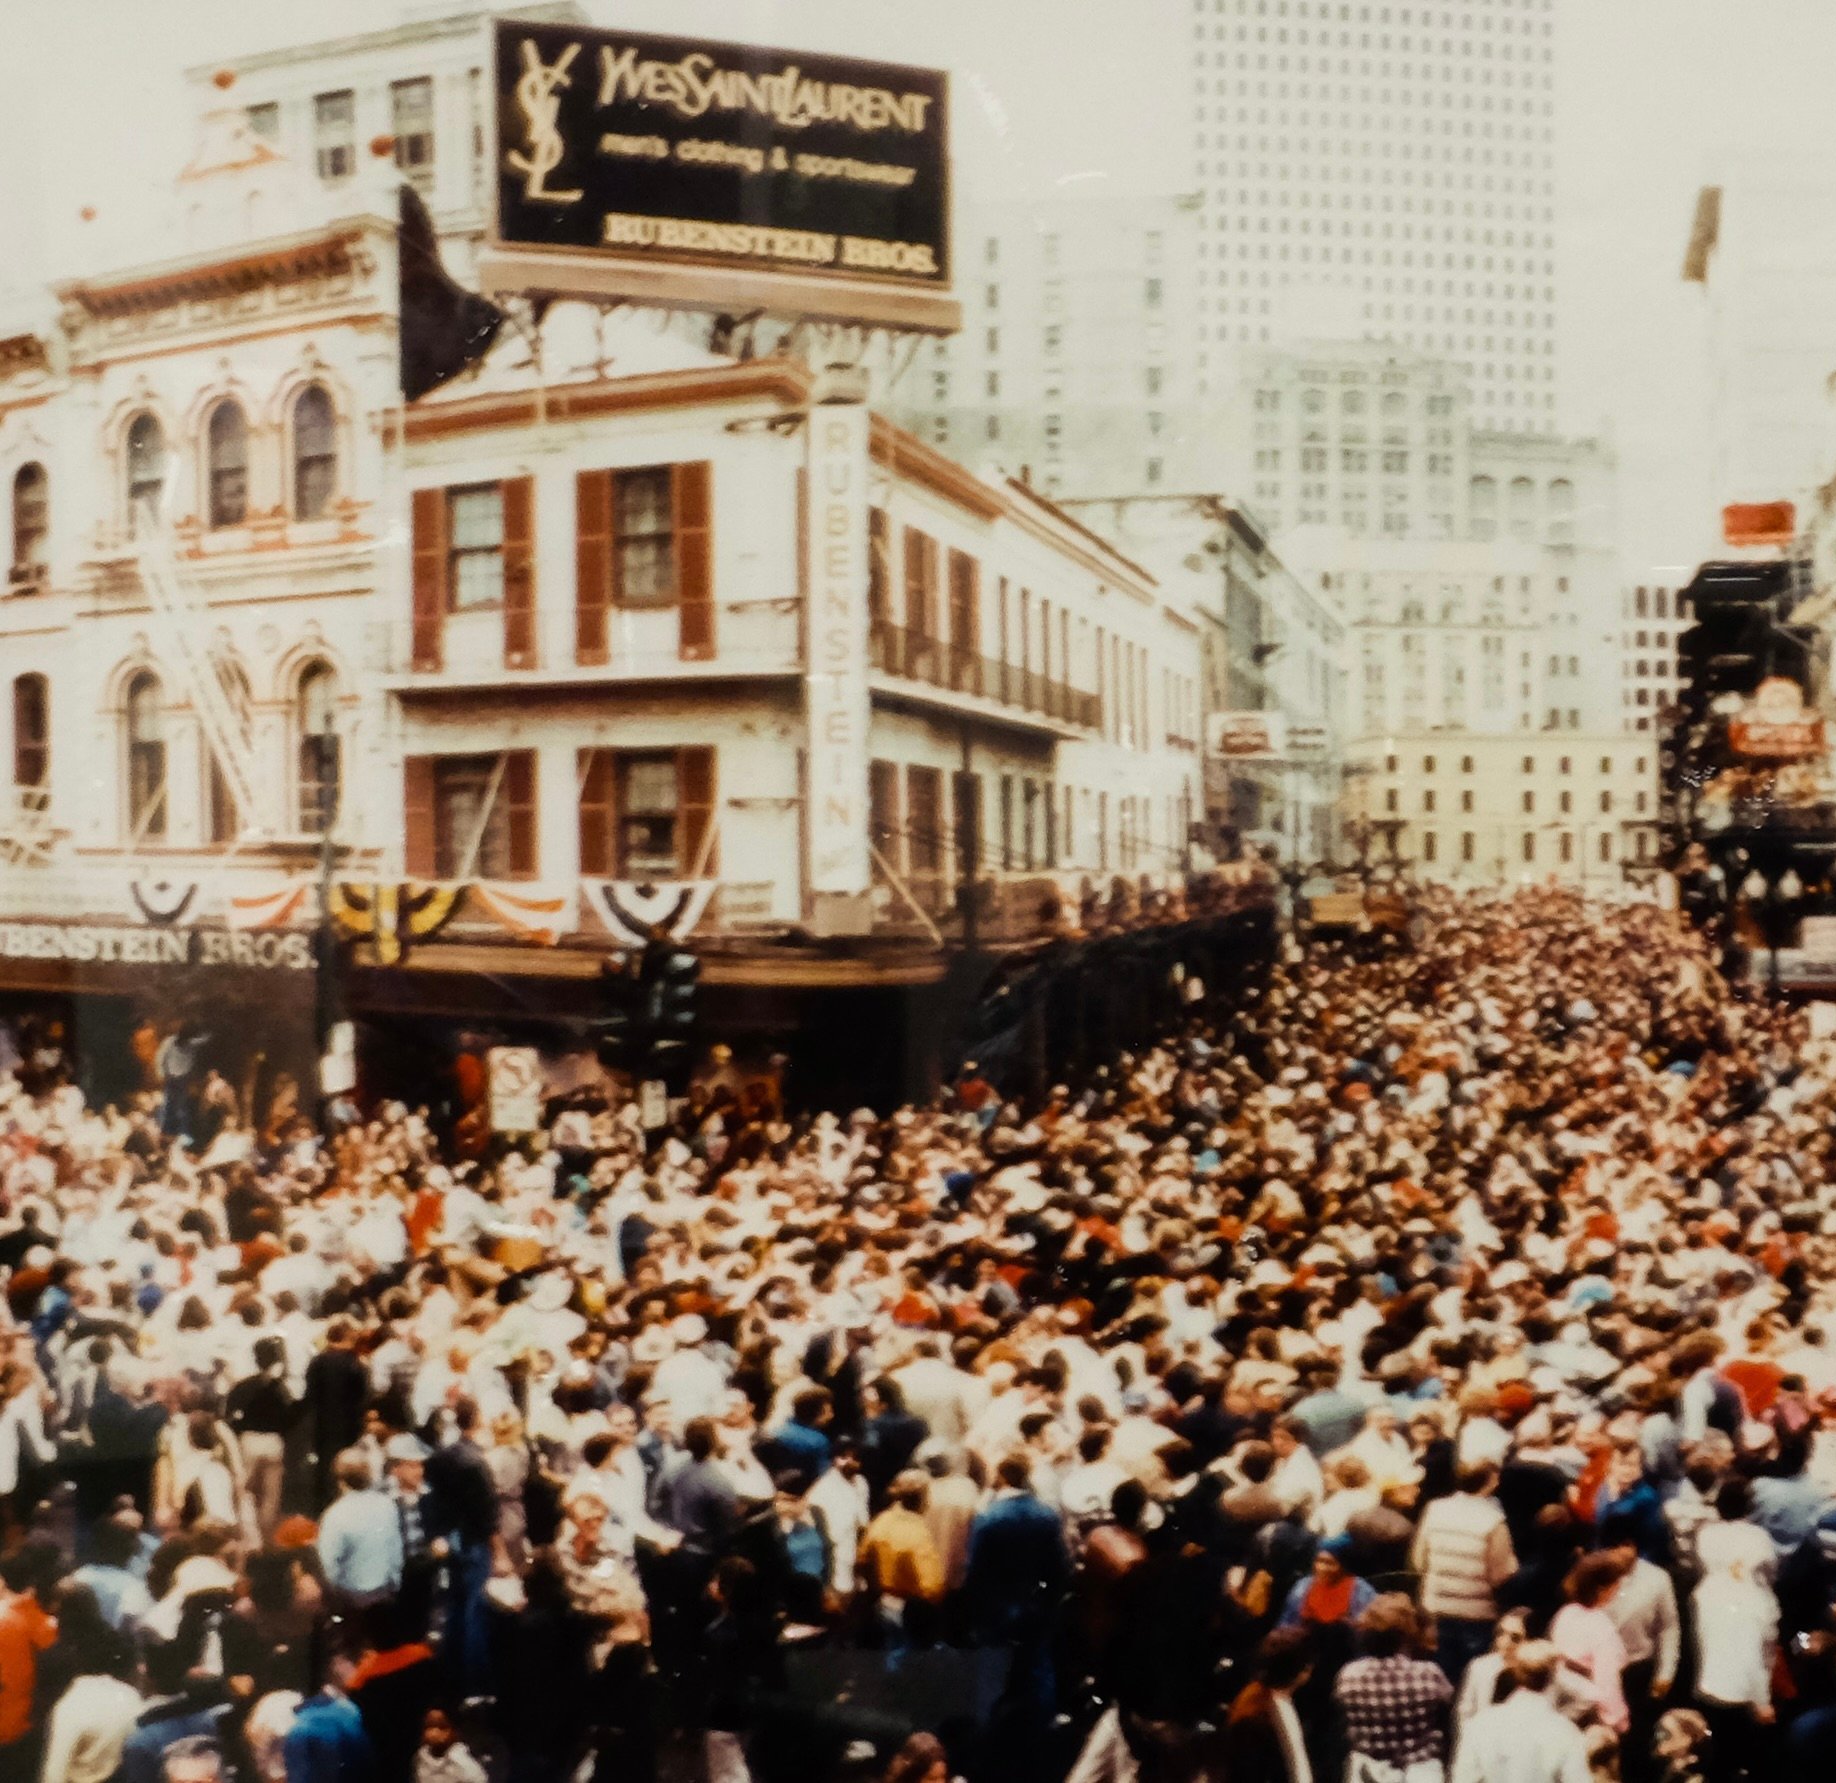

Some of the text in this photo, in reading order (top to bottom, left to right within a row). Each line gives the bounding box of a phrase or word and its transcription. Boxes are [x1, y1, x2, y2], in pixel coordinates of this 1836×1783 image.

[675, 137, 763, 174] clothing
[770, 145, 790, 171] &
[794, 153, 918, 187] sportswear
[603, 212, 940, 274] RUBENSTEIN BROS.
[823, 419, 853, 827] RUBENSTEIN
[0, 926, 319, 969] BENSTEIN BROS.
